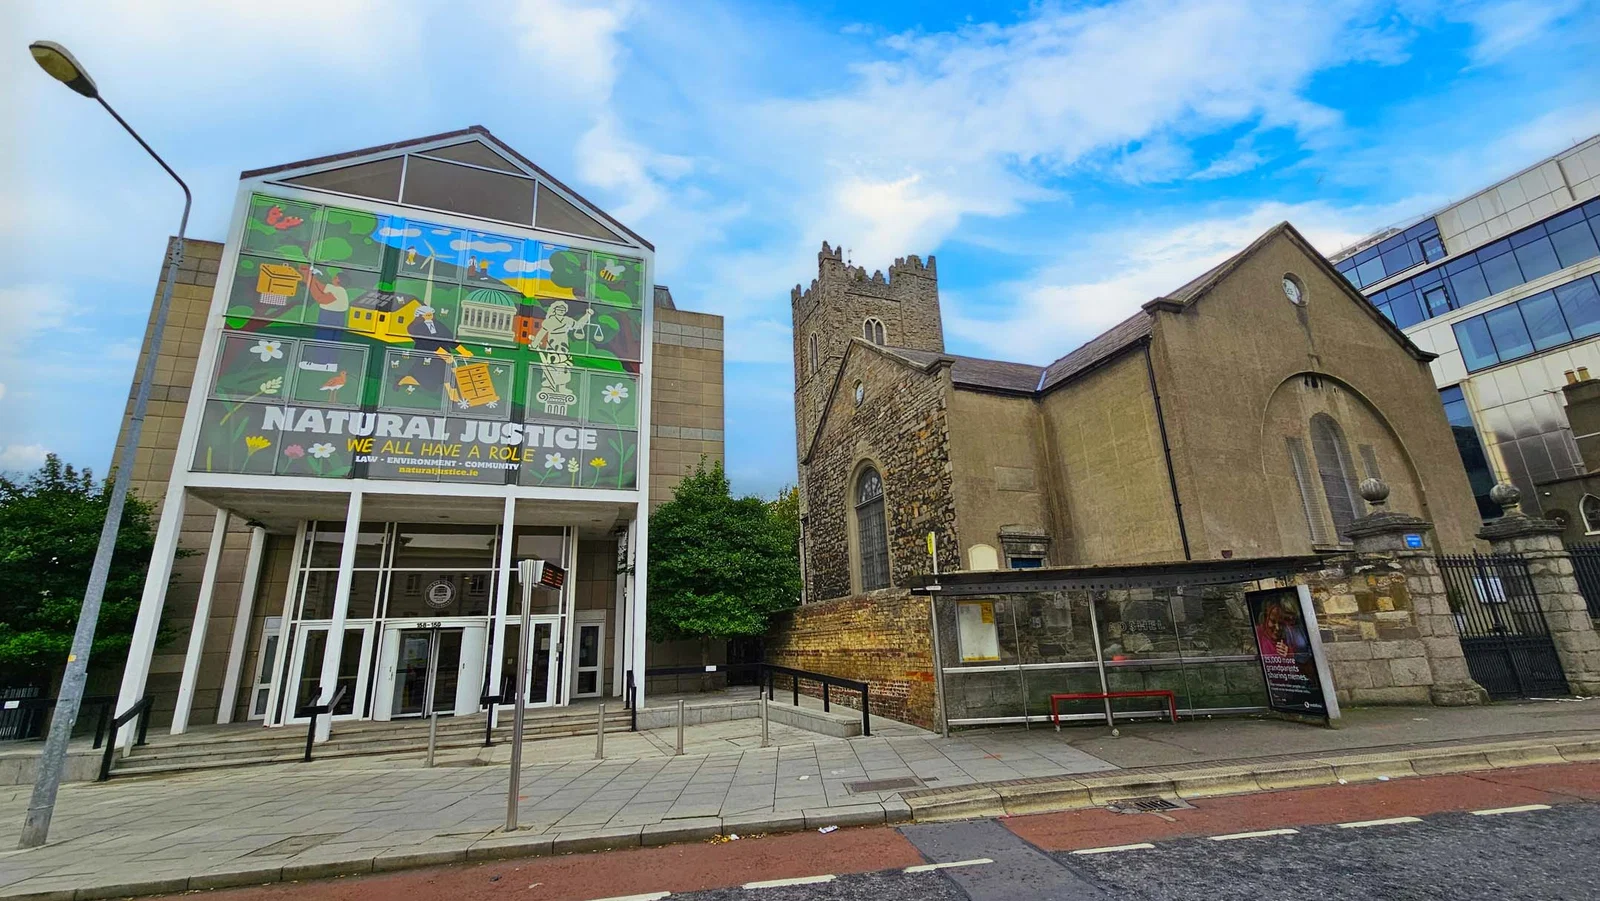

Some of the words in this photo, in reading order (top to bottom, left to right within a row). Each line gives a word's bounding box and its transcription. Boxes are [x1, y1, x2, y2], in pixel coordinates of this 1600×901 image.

[261, 406, 450, 441] NATURAL
[460, 420, 598, 450] JUSTICE
[346, 438, 376, 453] WE
[381, 440, 414, 455] ALL
[421, 443, 462, 458] HAVE
[467, 445, 480, 459] A
[489, 446, 536, 462] ROLE
[355, 455, 378, 463] LAW
[387, 456, 457, 467] ENVIRONMENT
[464, 461, 519, 471] COMMUNITY
[399, 466, 478, 477] naturaljustice.ie
[1268, 672, 1287, 681] sharing
